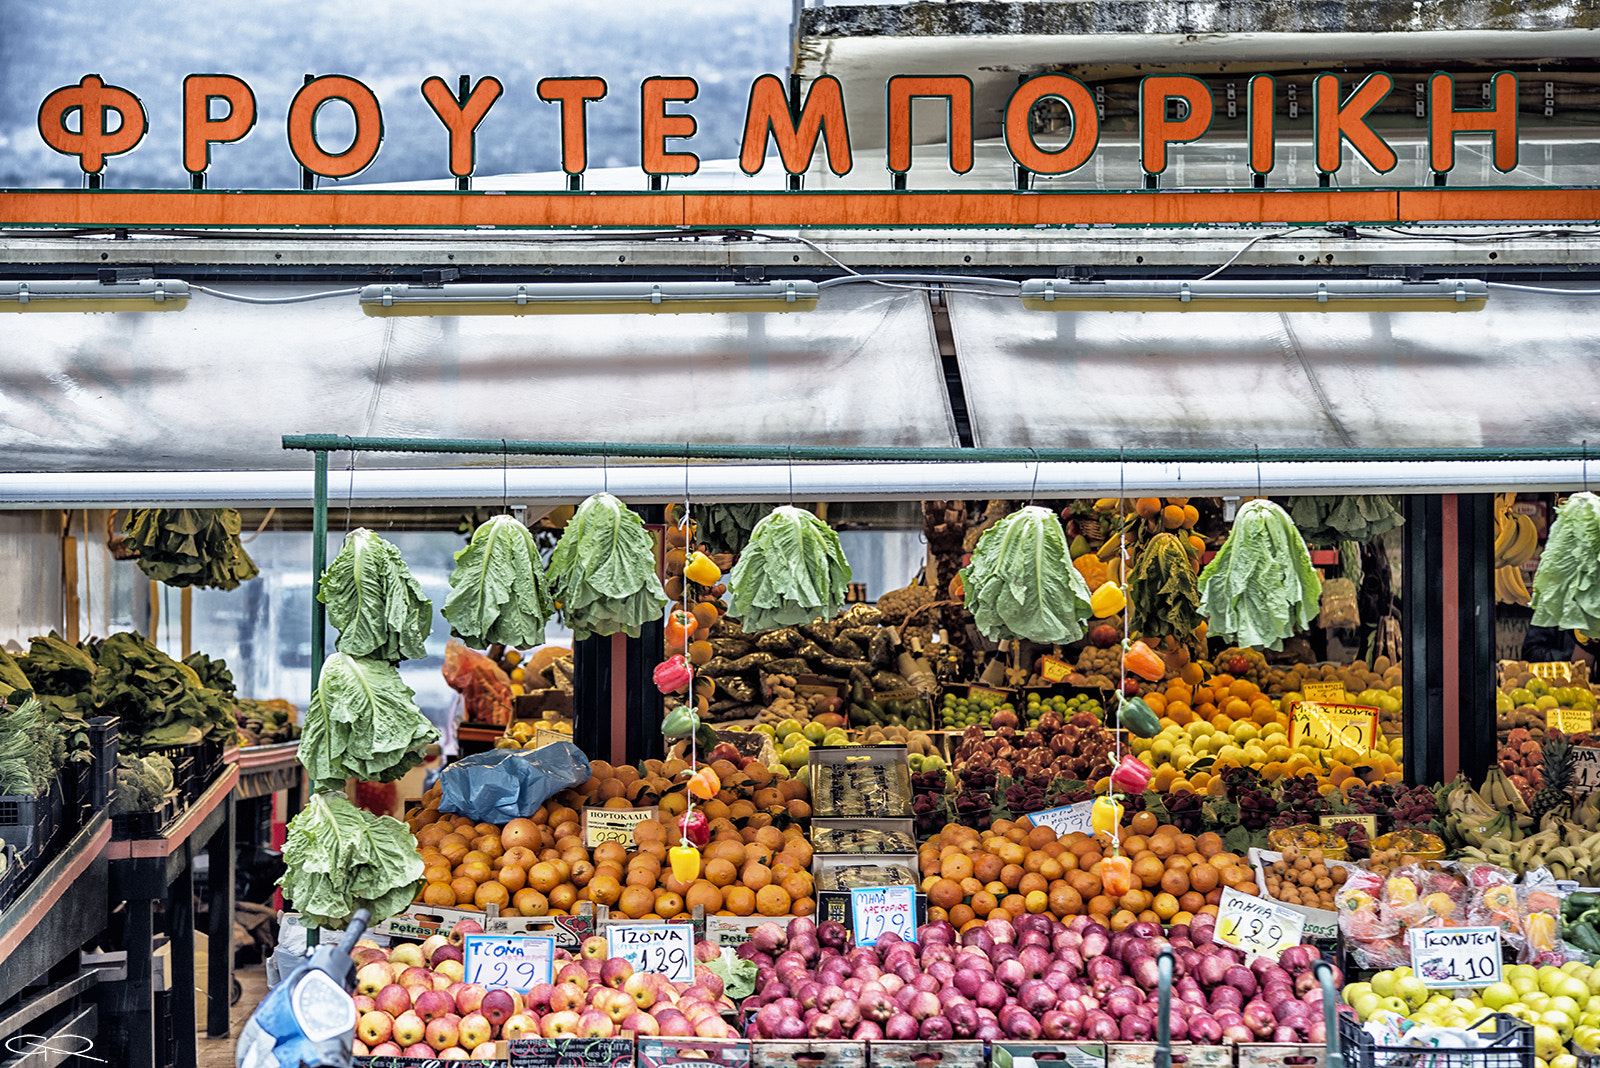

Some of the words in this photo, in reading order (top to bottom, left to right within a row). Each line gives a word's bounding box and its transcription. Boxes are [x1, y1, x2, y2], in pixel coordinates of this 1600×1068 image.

[37, 71, 1520, 180] ΦΡΟΥΤΕΜΠΟΡΙΚΗ
[590, 812, 649, 820] ΠΟΡΤΟΚΑΛΙΑ
[391, 922, 431, 936] Petras
[598, 1043, 631, 1051] FRUITA
